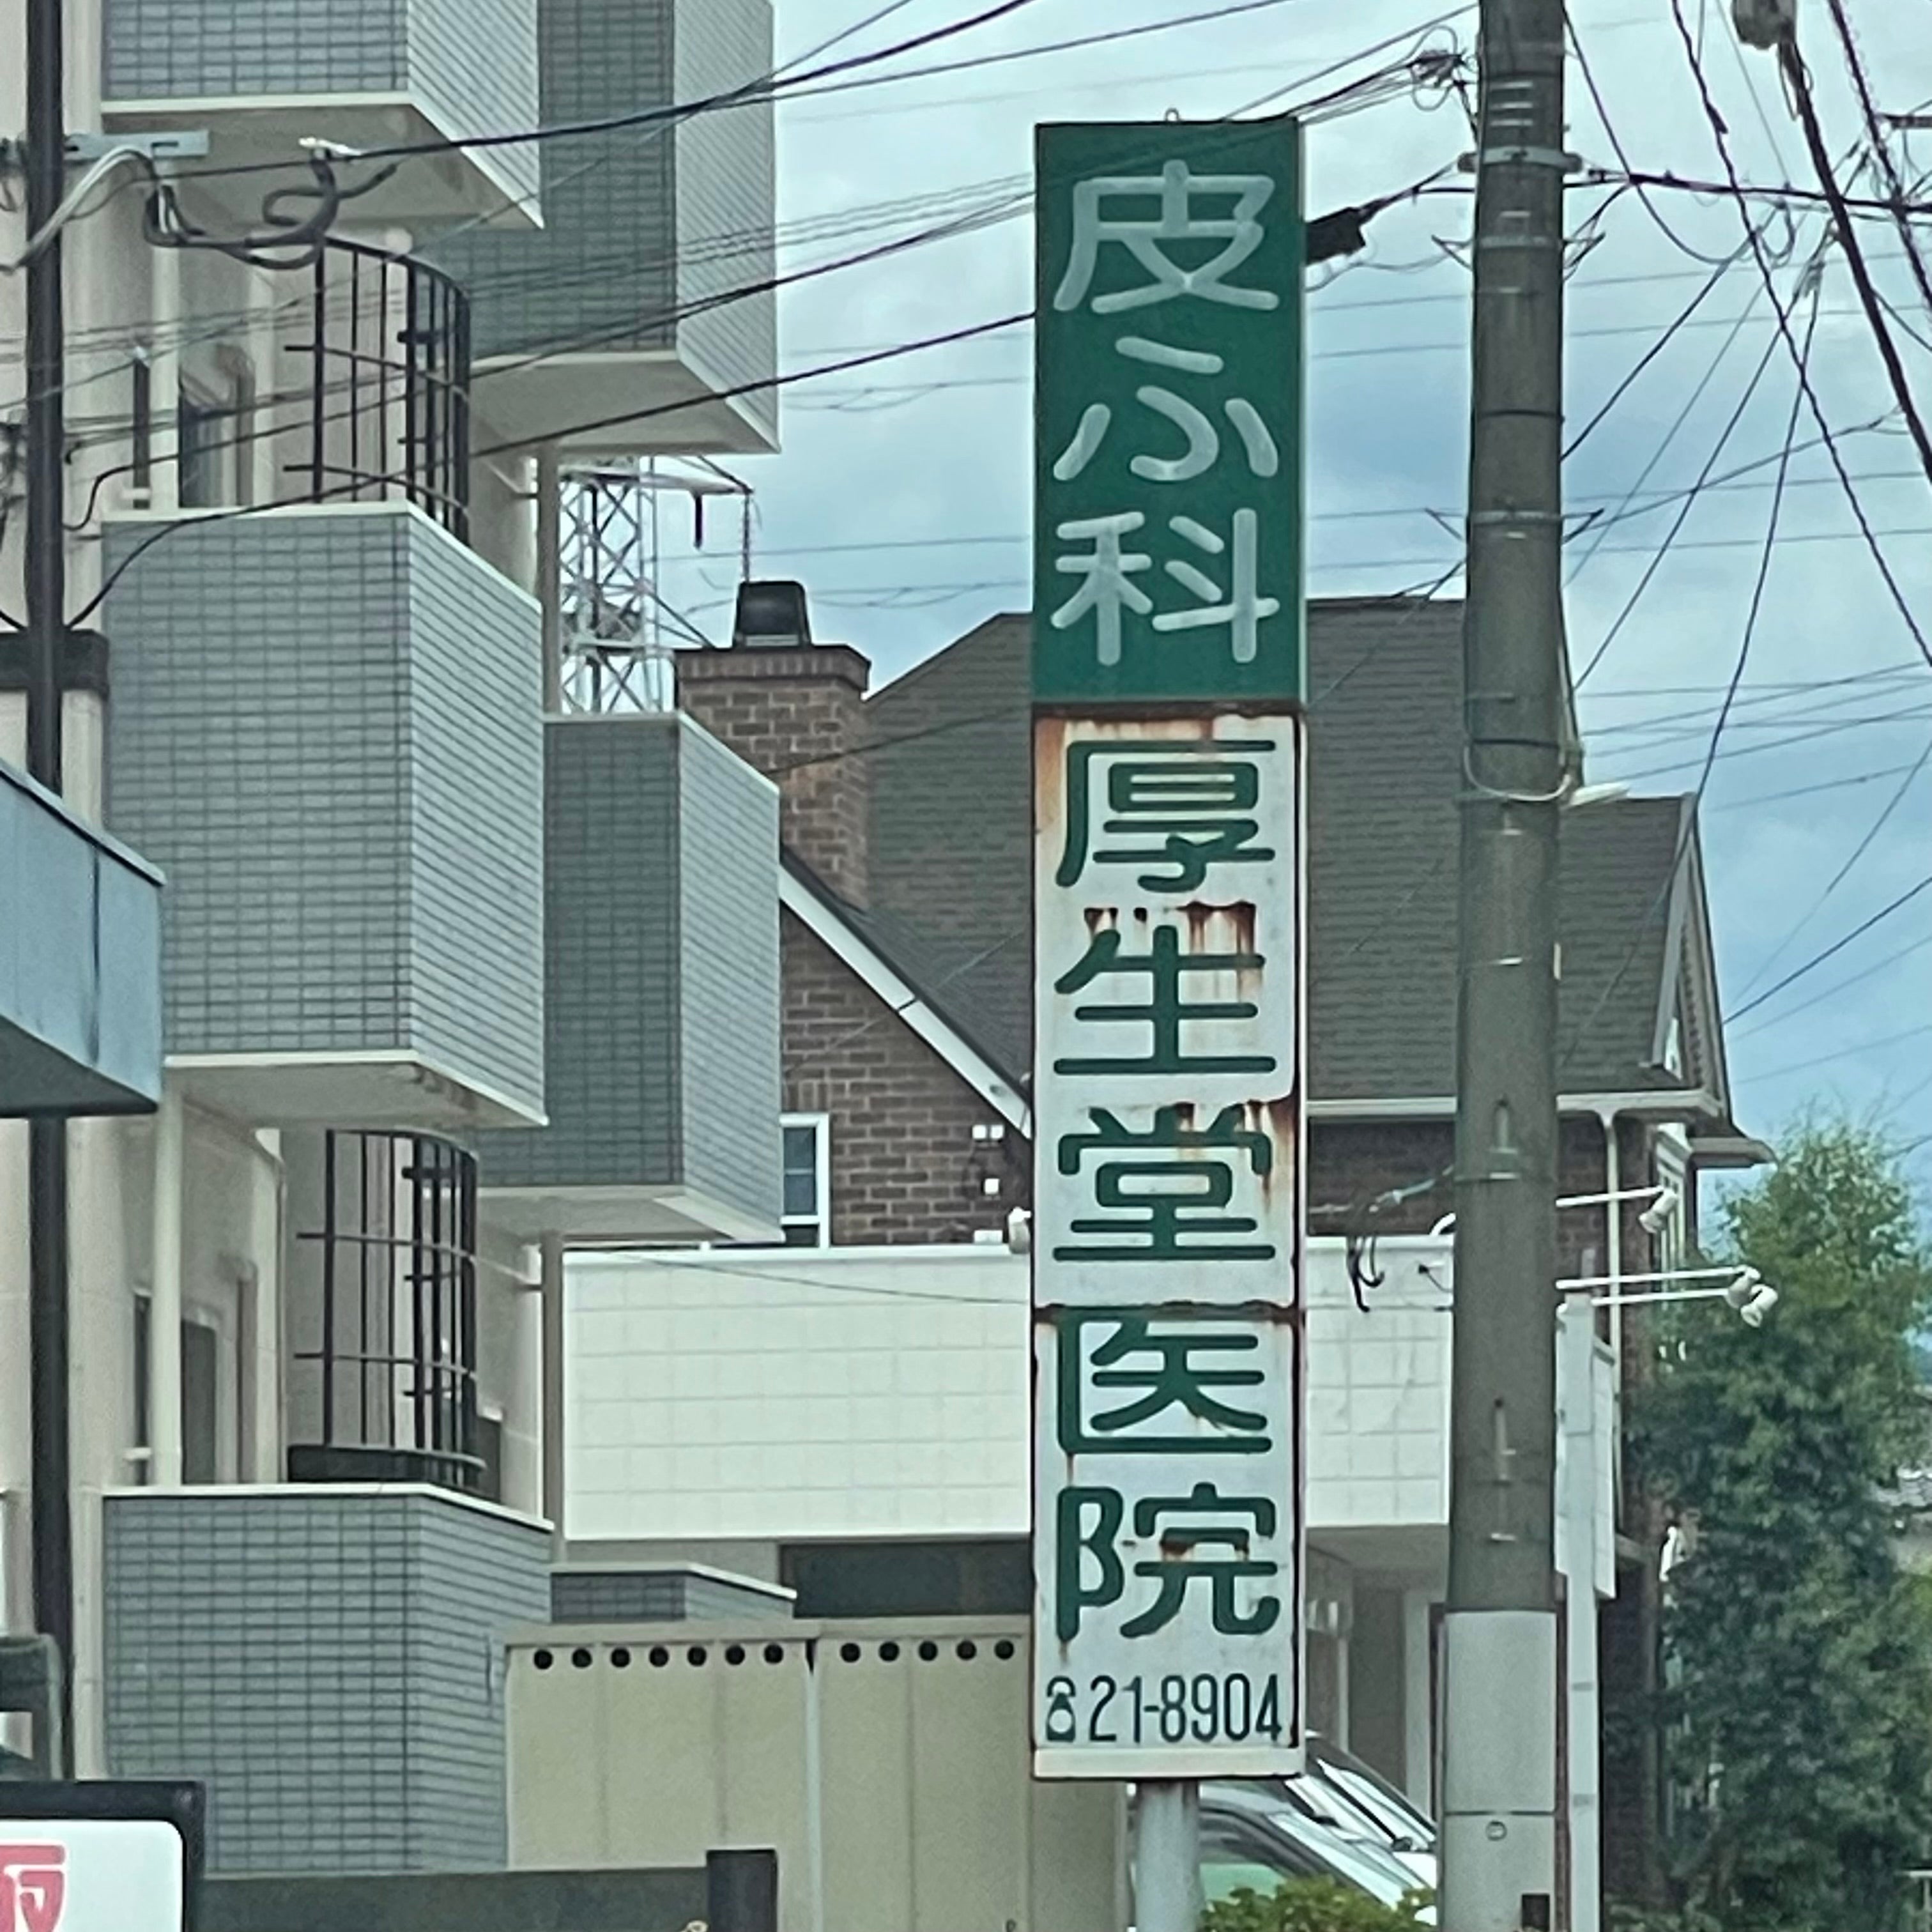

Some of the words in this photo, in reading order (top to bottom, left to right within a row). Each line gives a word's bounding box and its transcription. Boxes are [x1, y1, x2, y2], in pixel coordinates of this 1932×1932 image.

[1051, 158, 1280, 666] 皮ふ科
[1053, 739, 1280, 1639] 厚生堂医院
[1089, 1673, 1282, 1744] 21-8904
